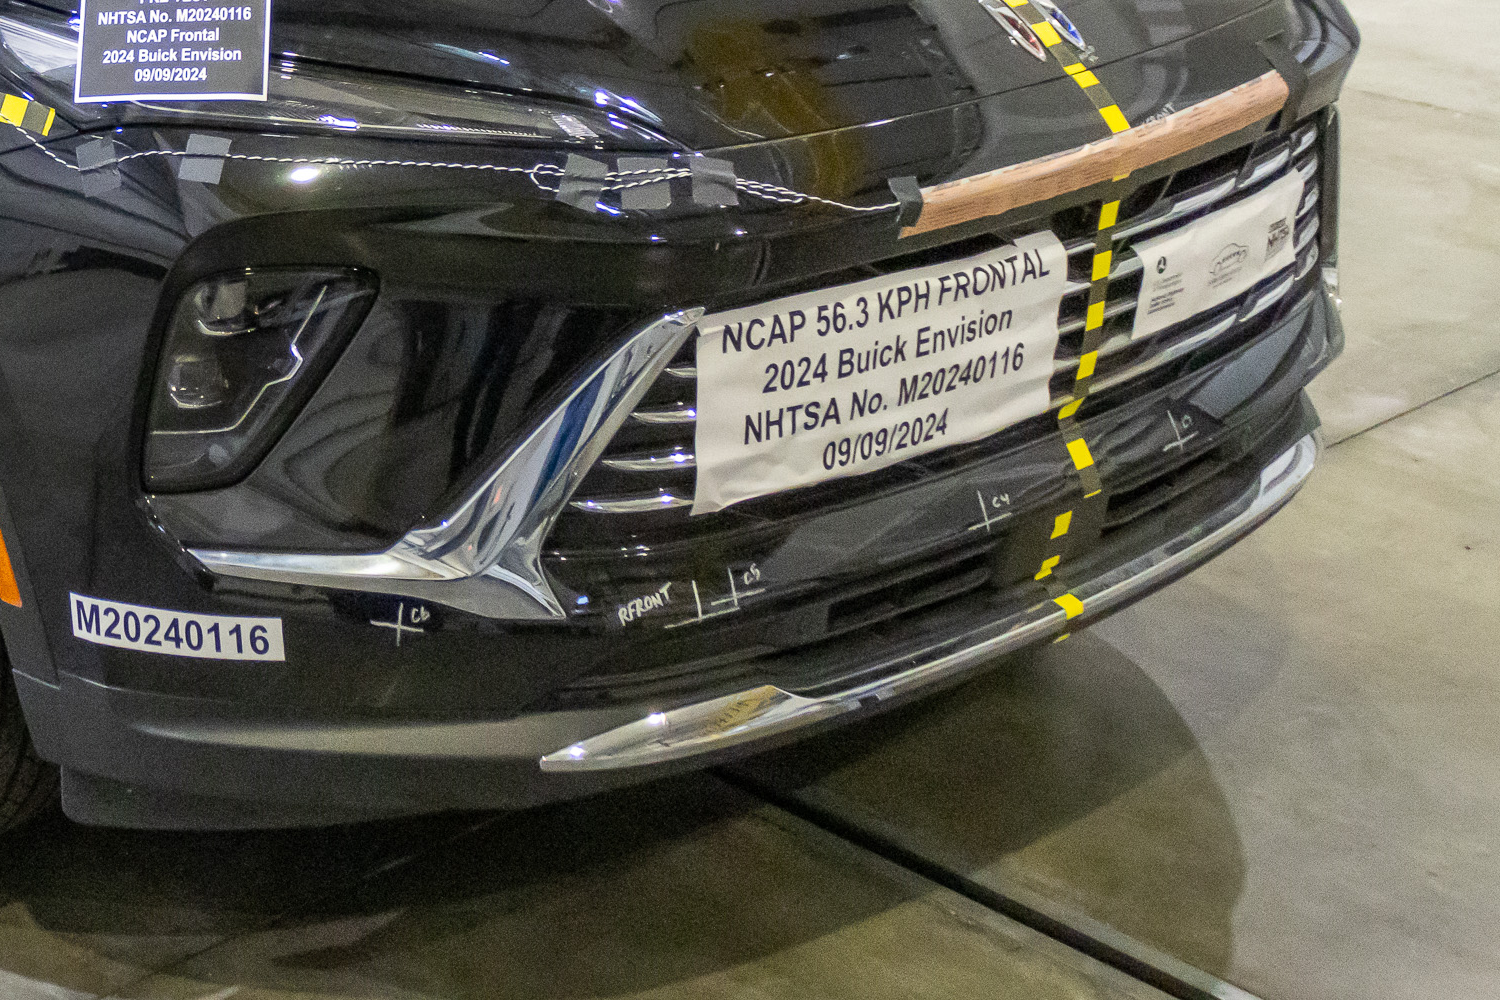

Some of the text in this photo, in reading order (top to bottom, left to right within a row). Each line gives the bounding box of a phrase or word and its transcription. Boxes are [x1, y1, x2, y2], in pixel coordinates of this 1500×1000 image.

[97, 7, 252, 25] NHTSA No. M20240116
[126, 27, 220, 43] NCAP Frontal
[102, 47, 242, 64] 2024 Buick Envision
[134, 67, 208, 82] 09/09/2024
[721, 249, 1051, 353] NCAP 56.3 KPH FRONTAL
[762, 309, 1013, 393] 2024 Buick Envision
[744, 343, 1025, 445] NHTSA No. M20240116
[822, 407, 949, 470] 09/09/2024
[991, 493, 1010, 508] C4
[76, 599, 270, 655] M20240116
[617, 581, 672, 627] RFRONT
